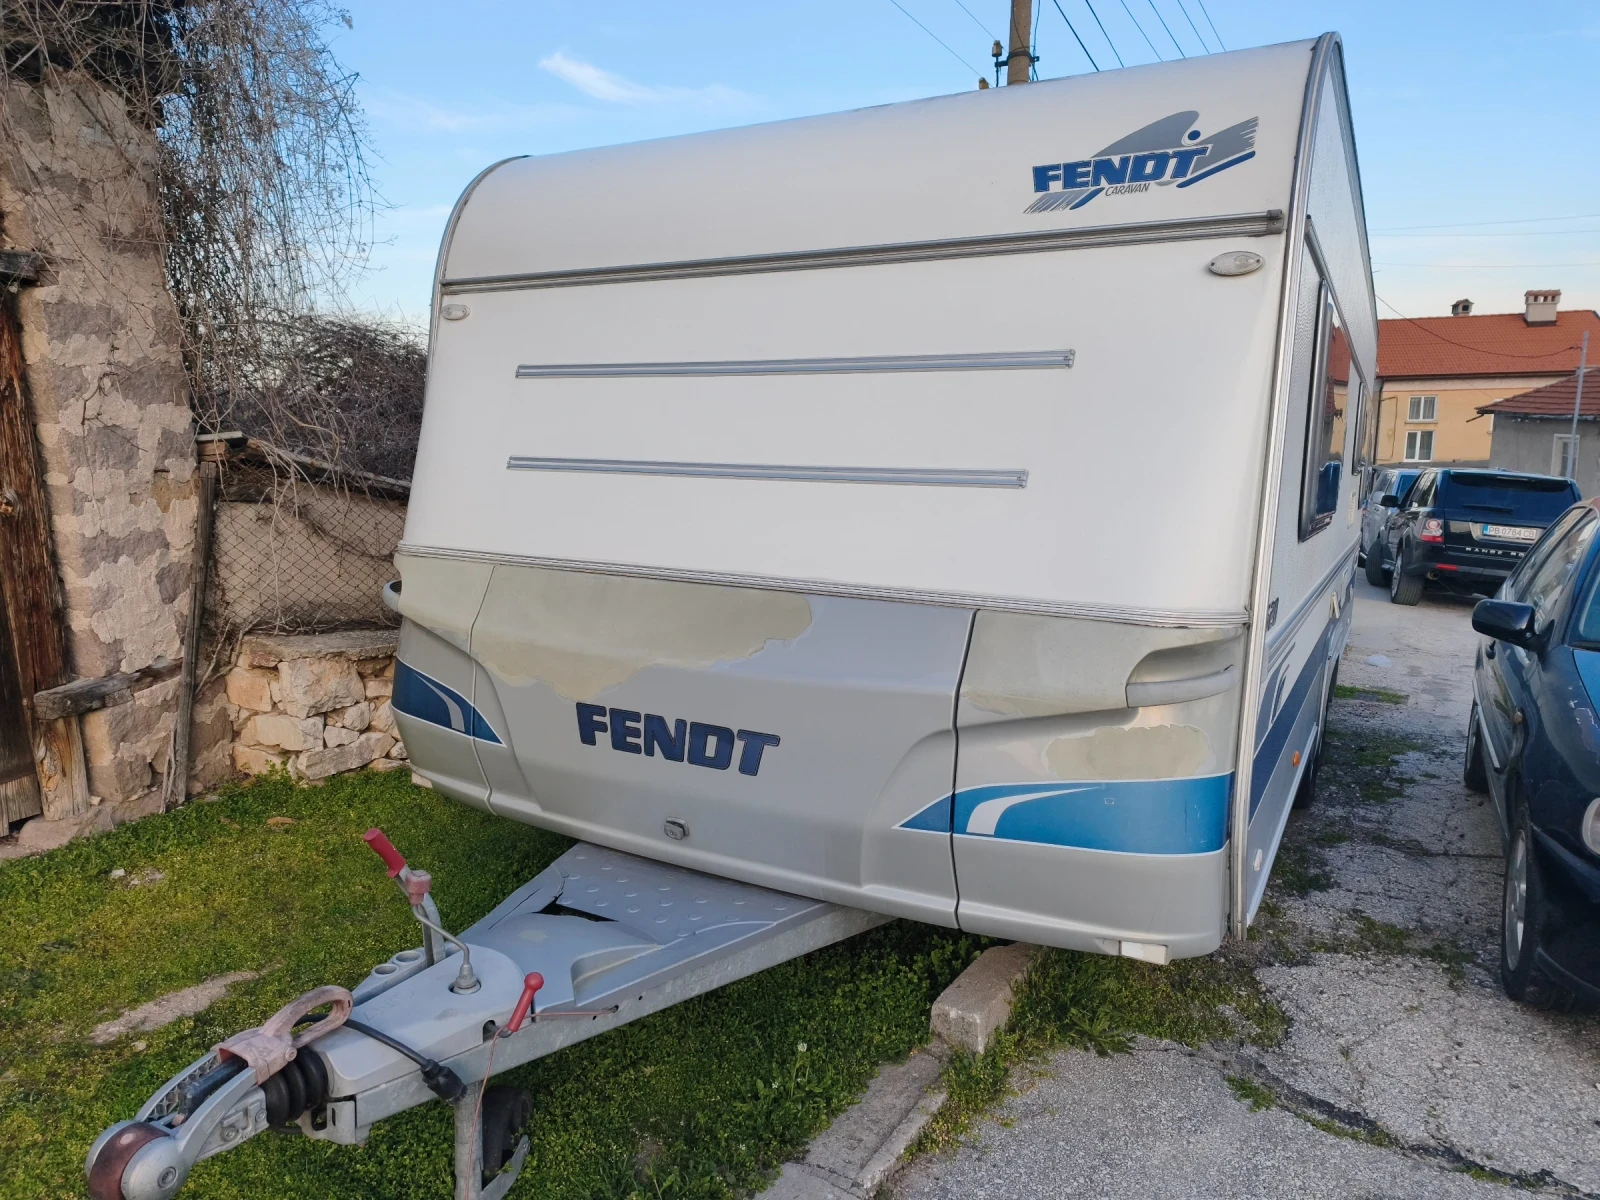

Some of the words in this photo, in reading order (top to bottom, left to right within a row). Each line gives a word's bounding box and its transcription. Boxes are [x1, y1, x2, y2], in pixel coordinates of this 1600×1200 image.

[1032, 147, 1210, 193] FENDT
[1105, 182, 1151, 197] CARAVAN
[1488, 526, 1500, 535] PB
[1501, 527, 1522, 536] 0784
[1523, 529, 1535, 538] CB
[576, 702, 781, 777] FENDT
